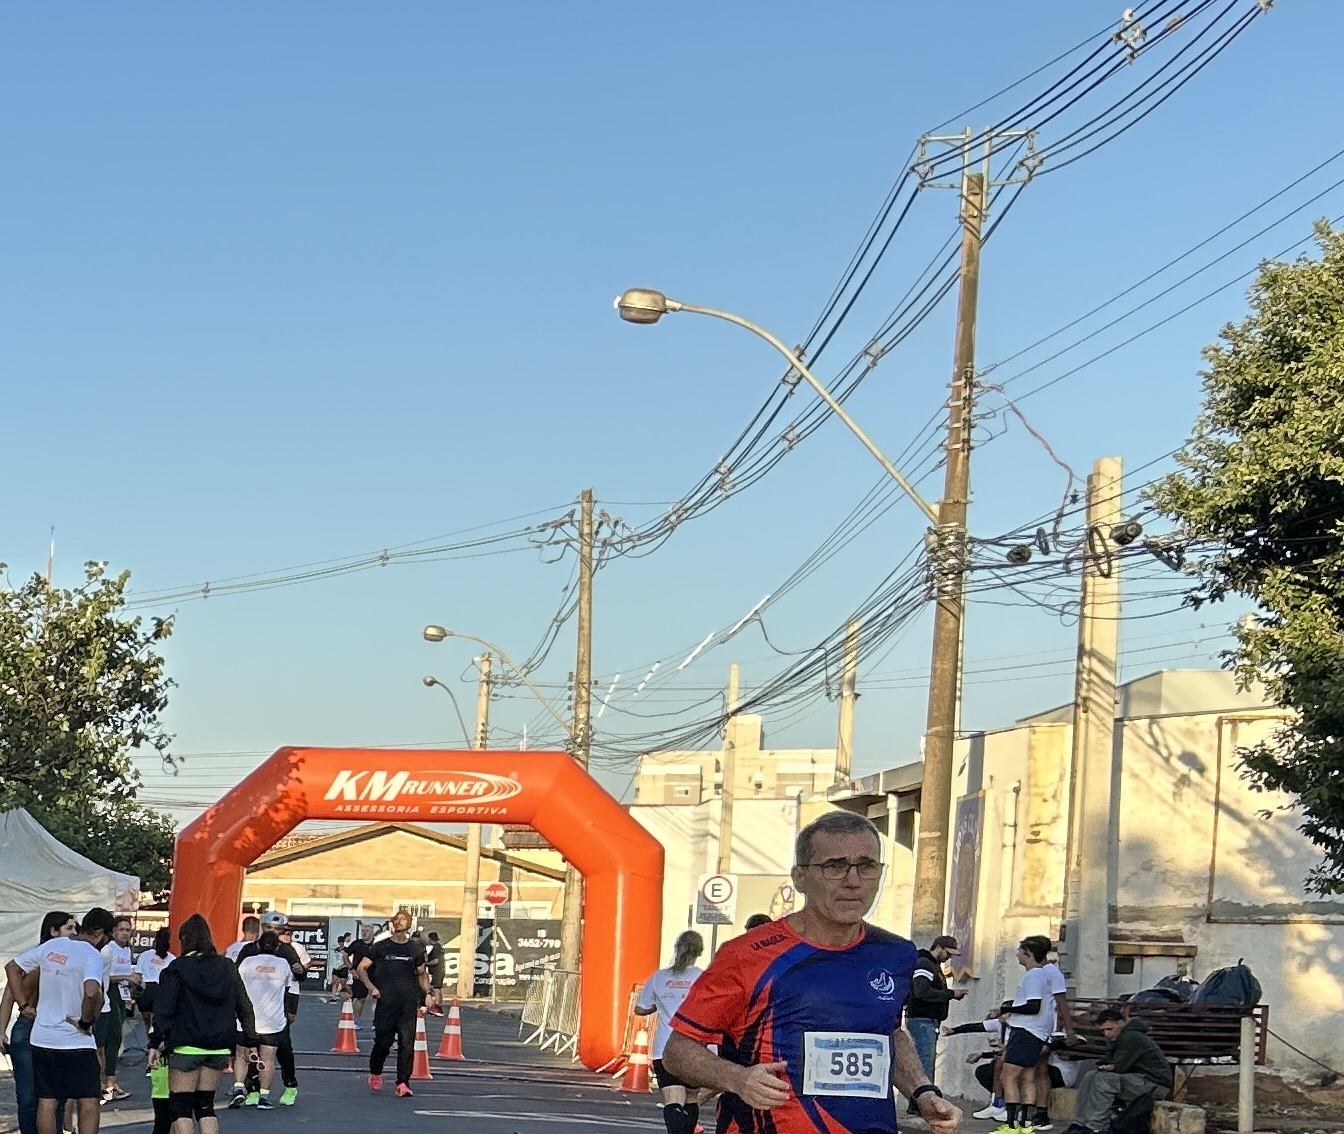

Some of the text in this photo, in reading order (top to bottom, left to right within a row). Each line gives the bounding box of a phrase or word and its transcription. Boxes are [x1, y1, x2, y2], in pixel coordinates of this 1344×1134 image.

[333, 804, 508, 815] ASSESSORIA ESPORTIVA
[712, 883, 724, 898] E
[444, 952, 515, 975] asa
[830, 1052, 873, 1077] 585
